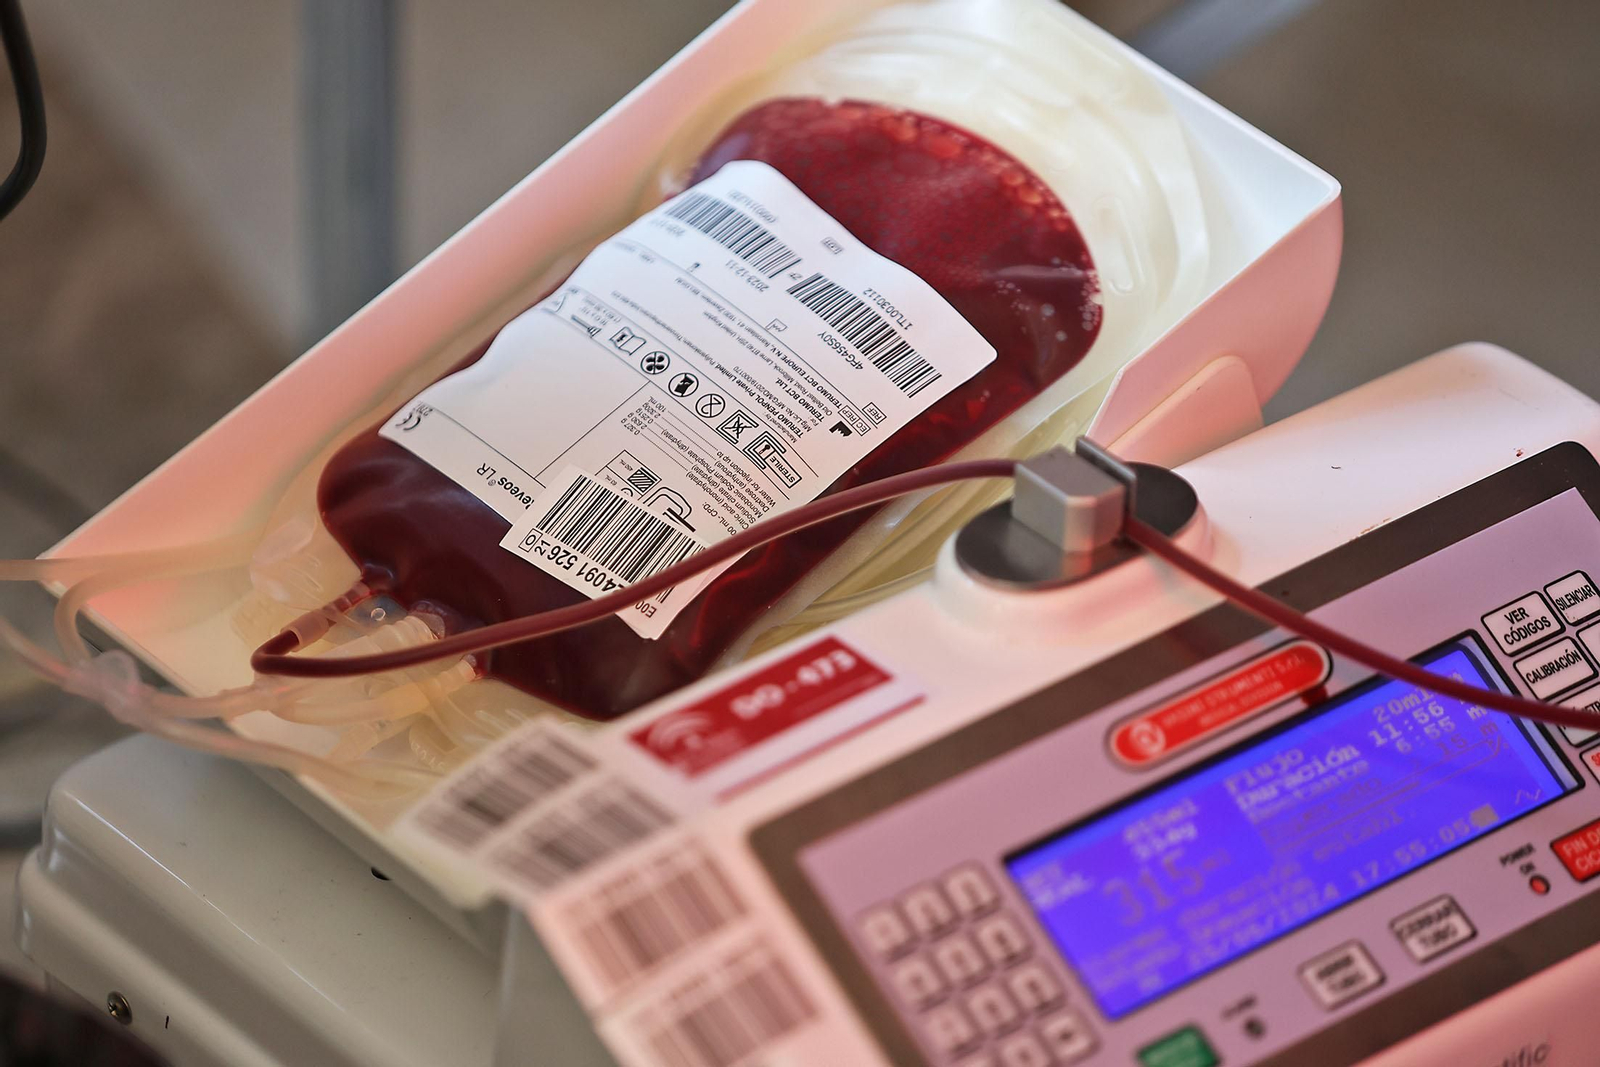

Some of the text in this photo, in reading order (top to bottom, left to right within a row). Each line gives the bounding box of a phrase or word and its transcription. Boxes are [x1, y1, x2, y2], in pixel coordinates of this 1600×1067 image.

[862, 287, 913, 330] 1TL0030112
[780, 354, 806, 376] EUROPE
[735, 379, 756, 397] Private
[803, 374, 818, 387] BCT
[647, 395, 657, 405] mL
[654, 402, 666, 412] 100
[754, 394, 779, 416] PENPOL
[775, 377, 824, 422] TERUMO BCT Ltd.
[816, 385, 842, 409] TERUMO
[841, 409, 867, 432] EC REP
[866, 407, 882, 420] REF
[623, 422, 640, 435] 0.327
[777, 413, 803, 438] TERUMO
[660, 428, 689, 452] (dihydrate)
[687, 449, 715, 474] Phosphate
[722, 455, 731, 463] up
[766, 455, 795, 483] STERILE
[476, 462, 496, 480] LR
[690, 463, 720, 489] (dihydrate)
[713, 459, 747, 489] (anhydrous)
[713, 470, 735, 491] Sodium
[729, 461, 753, 484] injection
[685, 470, 724, 504] (monohydrate)
[718, 486, 736, 503] citrate
[750, 481, 760, 491] for
[720, 502, 735, 514] acid
[732, 488, 763, 518] Monobasic
[744, 487, 769, 512] Dextrose
[758, 489, 776, 507] Water
[733, 513, 749, 531] Citric
[734, 501, 756, 524] Sodium
[546, 545, 578, 570] 526
[575, 561, 624, 602] 4091
[1554, 584, 1597, 611] SILENCIAR
[1504, 607, 1530, 625] VER
[1503, 615, 1551, 645] CÓDIGOS
[1525, 649, 1582, 684] CALIBRACIÓN
[1370, 701, 1443, 746] 11:56
